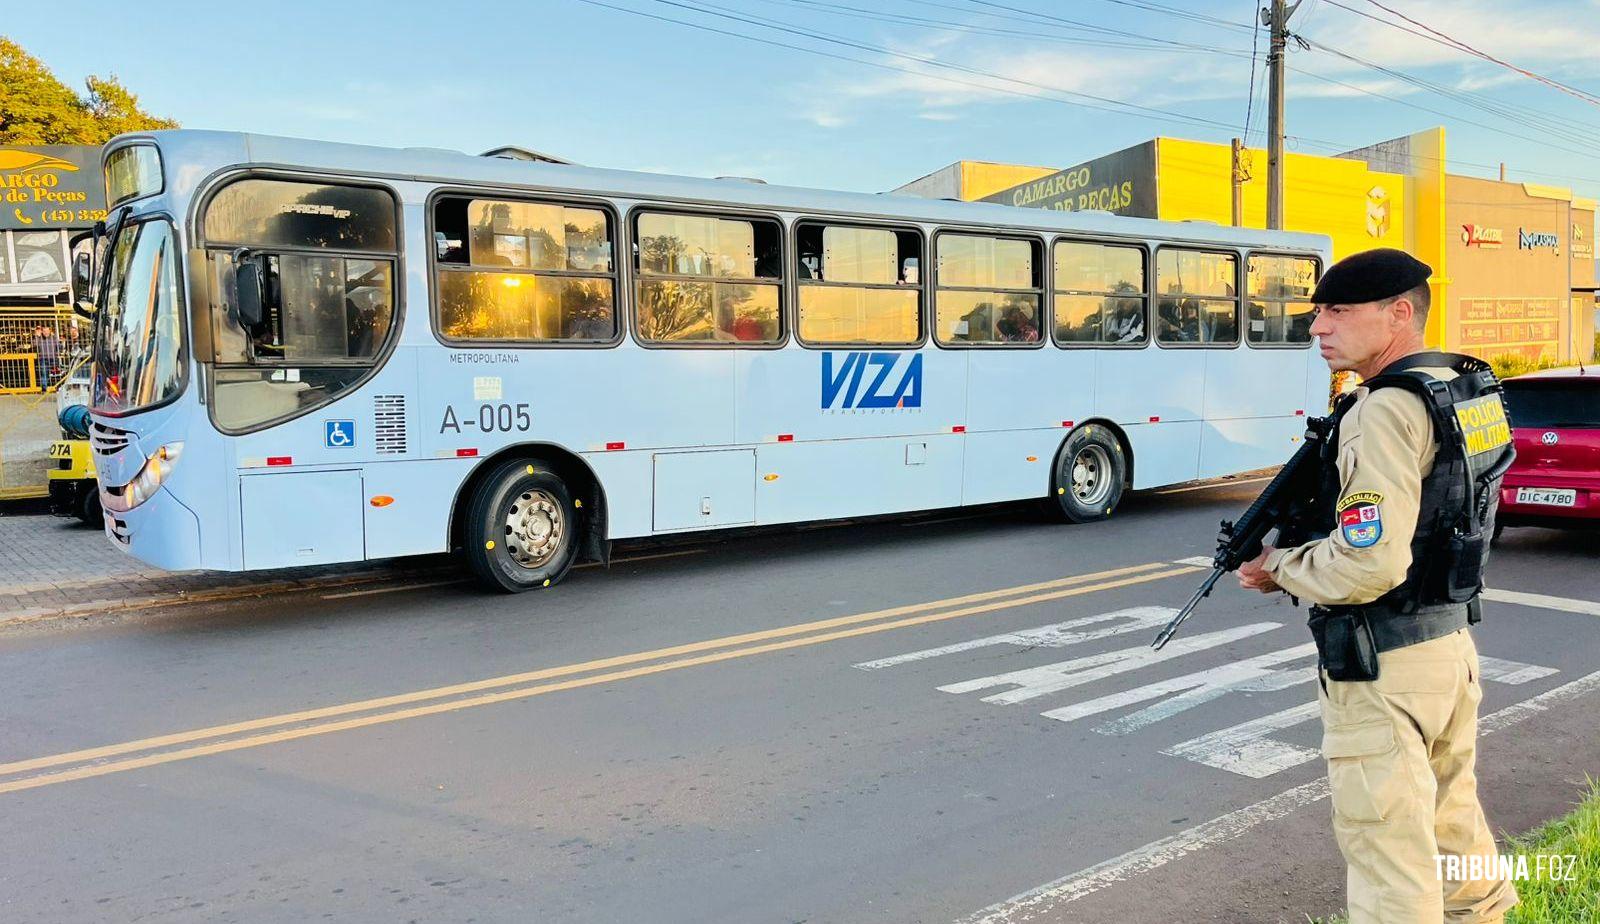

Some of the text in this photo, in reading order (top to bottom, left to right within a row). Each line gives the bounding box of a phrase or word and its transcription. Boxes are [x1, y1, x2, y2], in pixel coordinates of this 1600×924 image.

[6, 188, 28, 201] de
[33, 188, 86, 206] Peças
[1013, 168, 1091, 207] CAMARGO
[41, 209, 75, 223] (45)
[450, 353, 520, 364] METROPOLITANA
[821, 352, 923, 409] VIZA
[439, 403, 531, 434] A-005
[1458, 400, 1504, 431] POLÍCIA
[1466, 422, 1509, 454] MILITAR
[1519, 492, 1572, 504] DIC-4780
